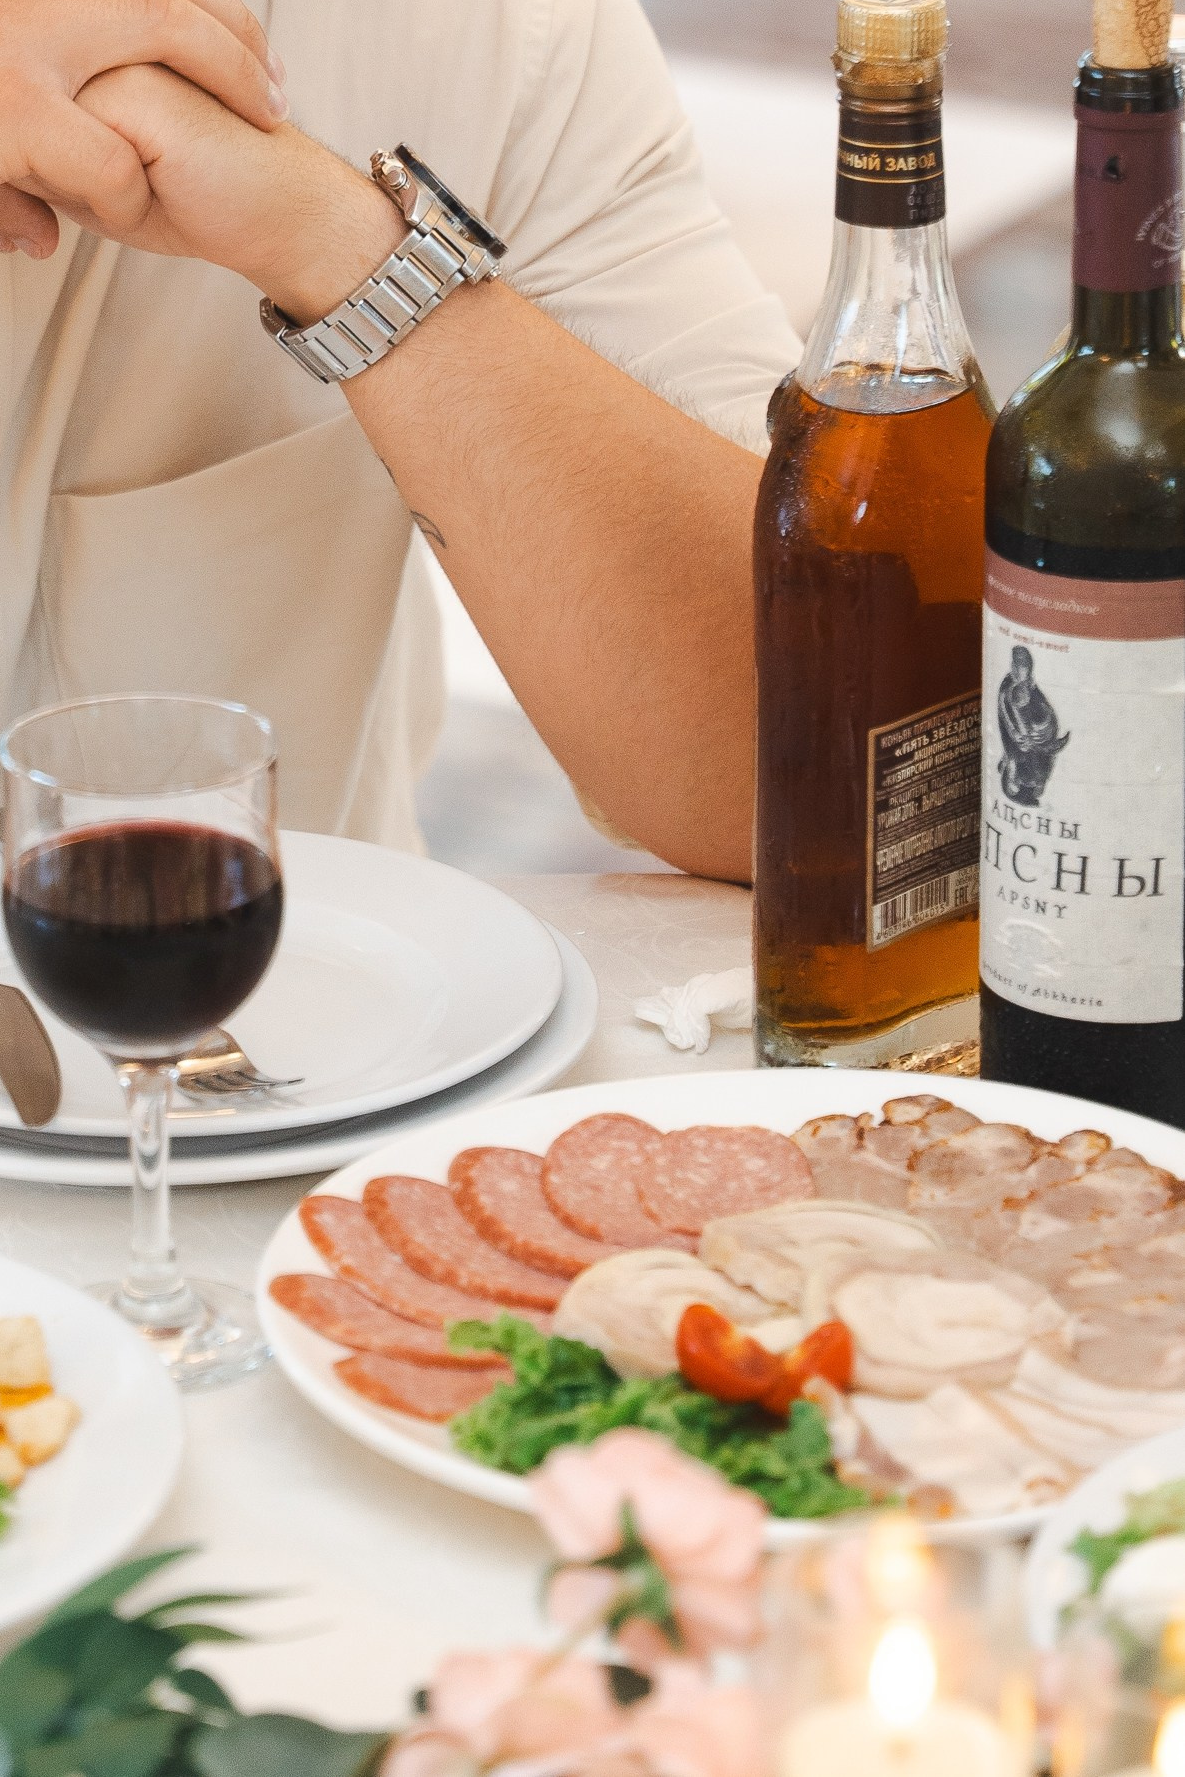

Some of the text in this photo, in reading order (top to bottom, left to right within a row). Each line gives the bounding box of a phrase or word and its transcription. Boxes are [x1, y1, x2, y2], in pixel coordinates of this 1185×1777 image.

[885, 150, 936, 172] ЗАВОД
[997, 885, 1069, 919] APSNY
[1017, 983, 1029, 995] of
[1031, 987, 1104, 1008] Abkhazia
